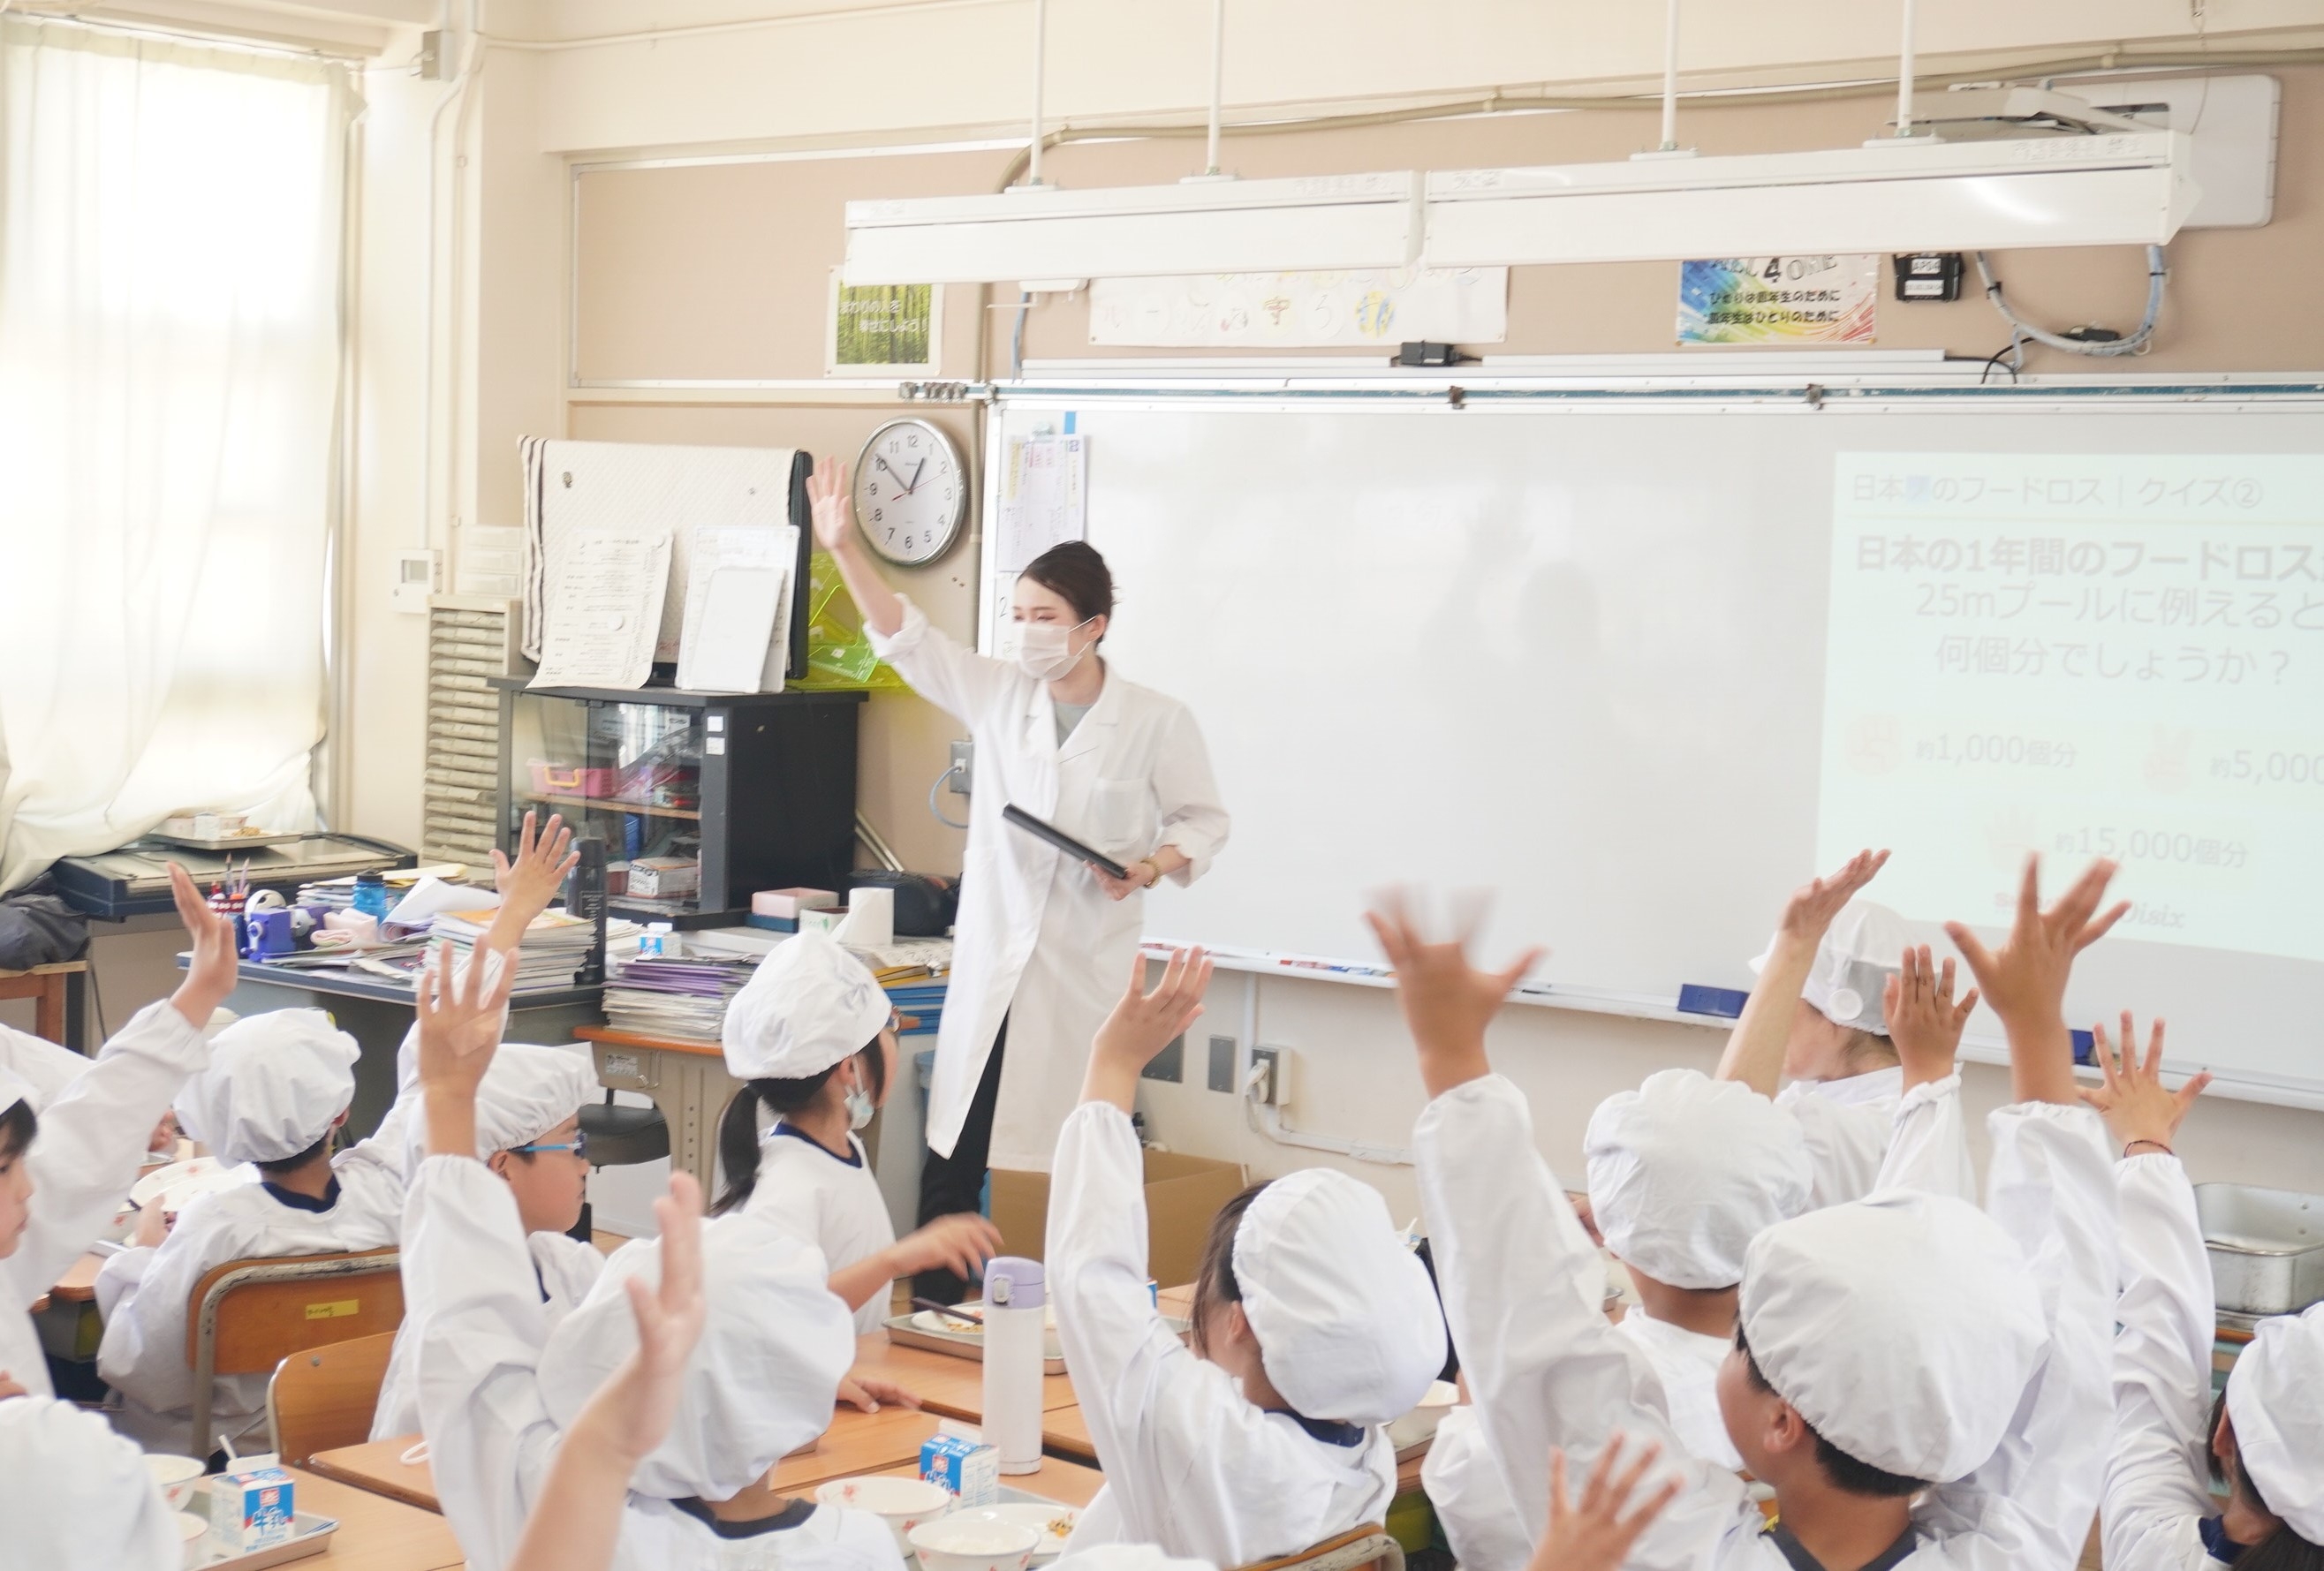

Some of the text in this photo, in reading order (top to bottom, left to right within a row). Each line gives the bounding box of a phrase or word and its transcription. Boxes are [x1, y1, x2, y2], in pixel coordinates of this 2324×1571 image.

[889, 440, 900, 454] 11
[906, 434, 920, 449] 12
[939, 460, 949, 474] 2
[869, 482, 953, 502] 9 3
[874, 508, 947, 526] 8 4
[887, 526, 933, 549] 7 6 5
[1856, 534, 2324, 583] 日本の1年間のフードロス
[1914, 580, 2324, 631] 25mプールに例えると
[1934, 634, 2291, 686] 何個分でしょうか？
